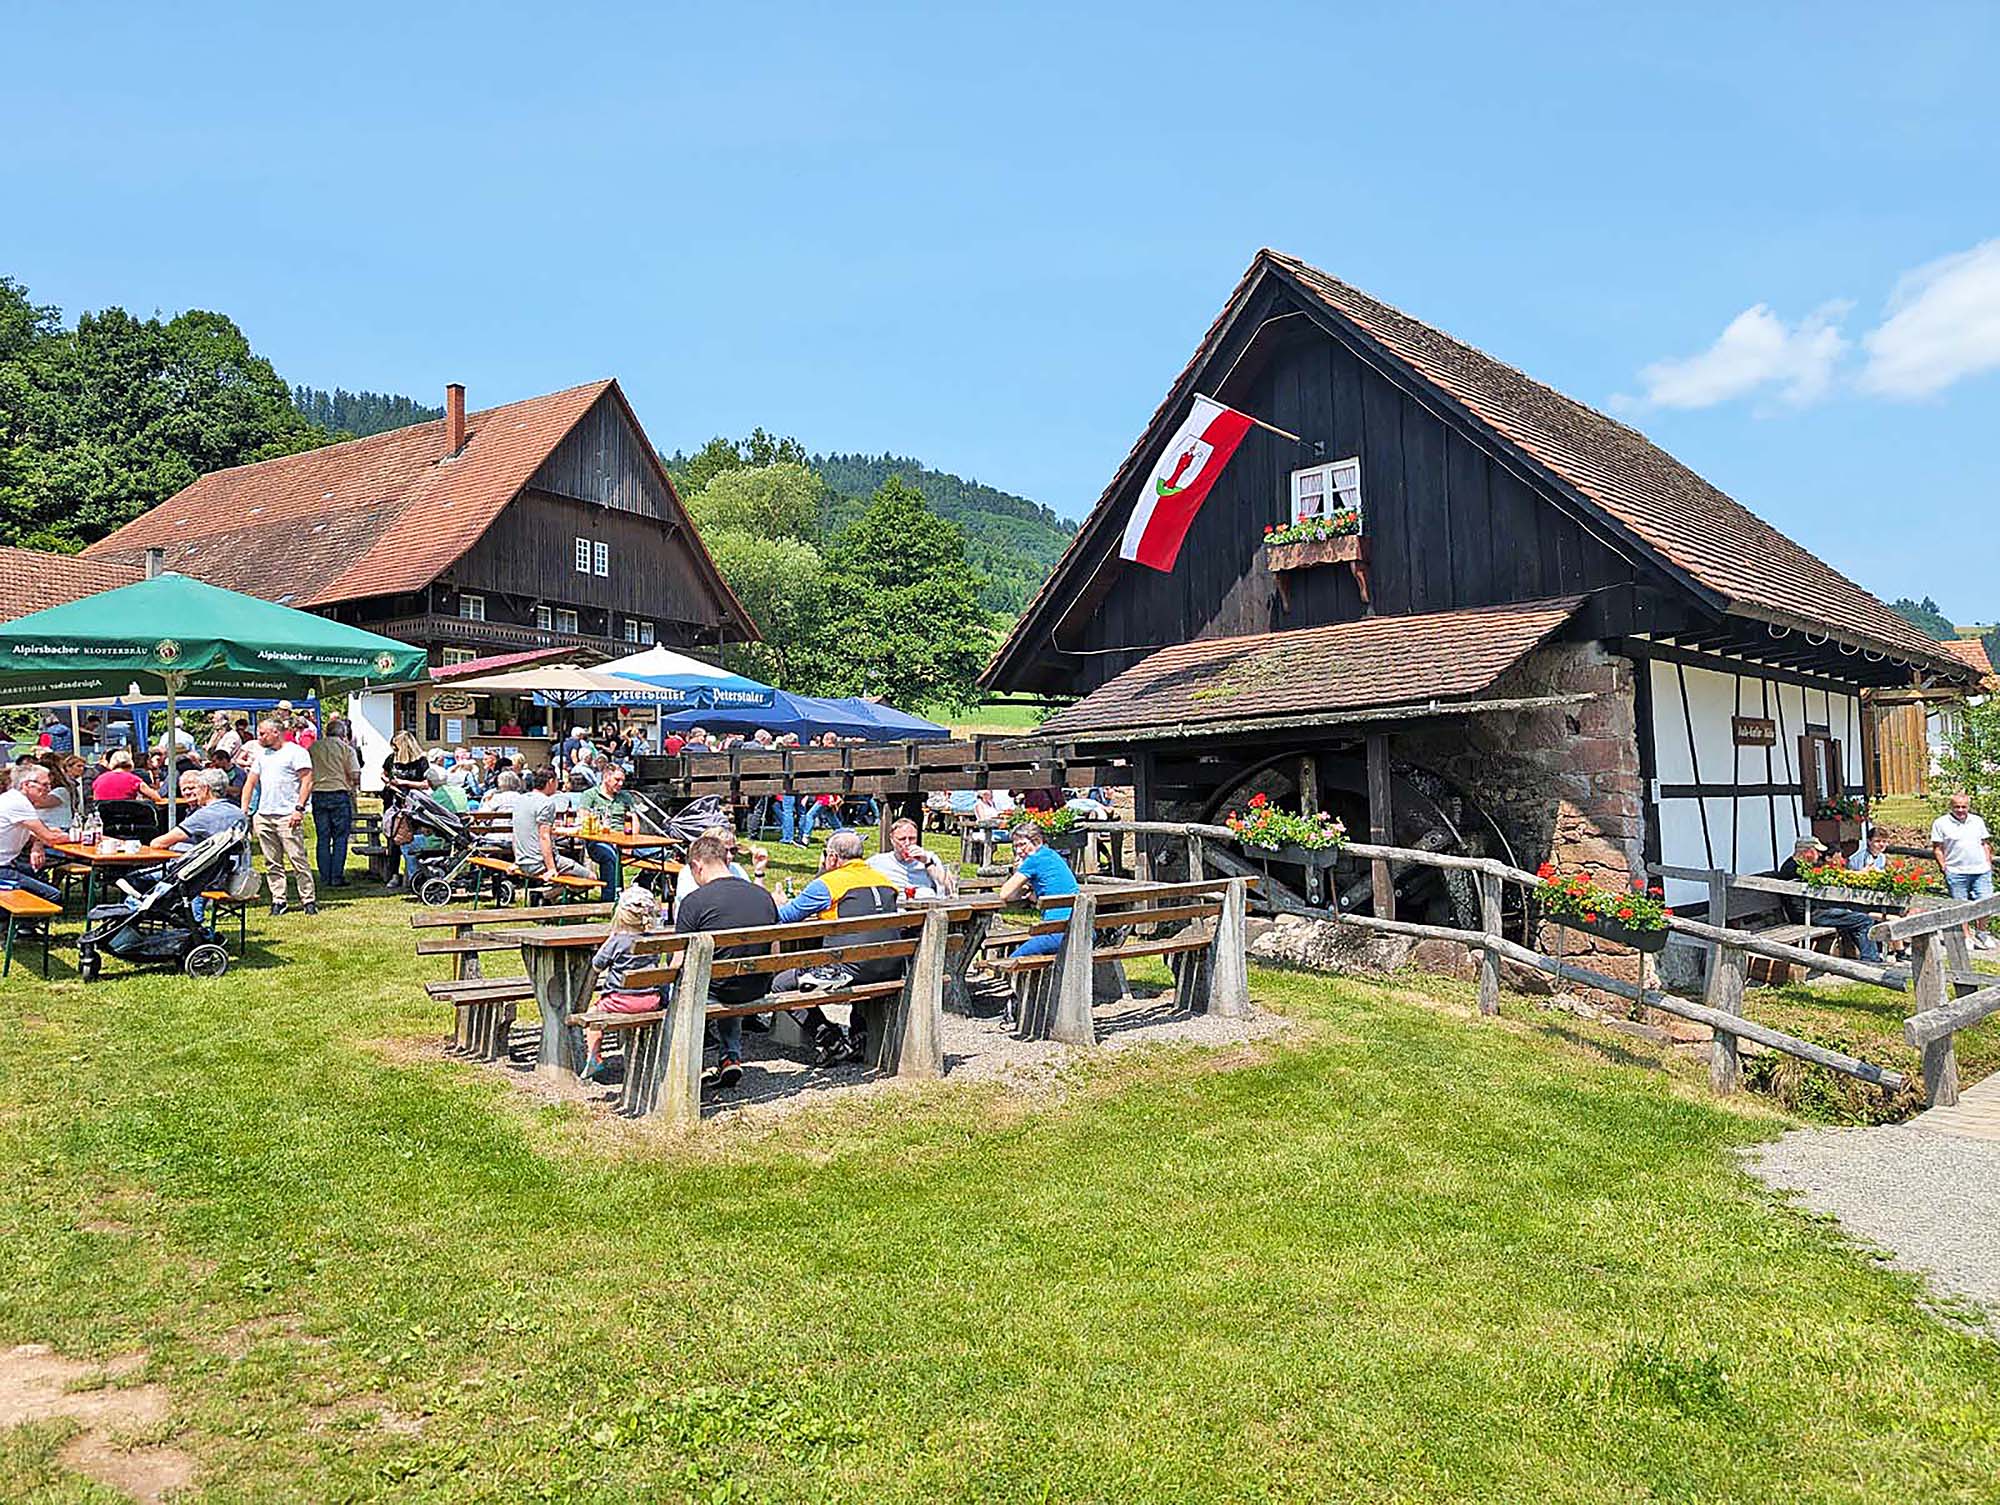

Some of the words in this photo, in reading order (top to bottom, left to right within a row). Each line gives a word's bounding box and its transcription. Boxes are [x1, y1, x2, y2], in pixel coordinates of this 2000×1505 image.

[12, 644, 79, 656] Alpirsbacher
[84, 646, 148, 655] KLOSTERBRÄU
[257, 650, 313, 662] Alpirsbacher
[712, 687, 764, 703] Peterstaler
